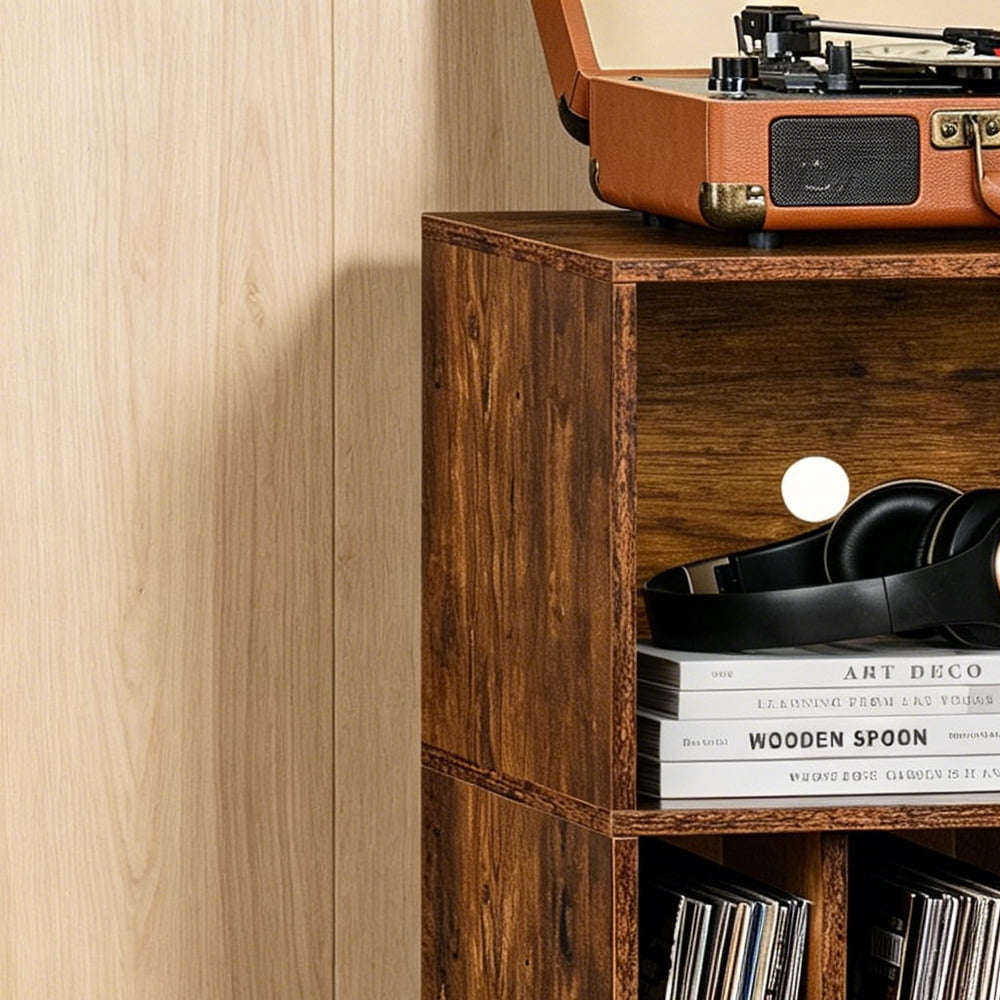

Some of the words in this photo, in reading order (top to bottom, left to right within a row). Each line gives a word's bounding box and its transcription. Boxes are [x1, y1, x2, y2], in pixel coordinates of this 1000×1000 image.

[843, 664, 896, 681] ART
[910, 663, 983, 680] DECO
[749, 731, 844, 750] WOODEN
[853, 728, 928, 748] SPOON
